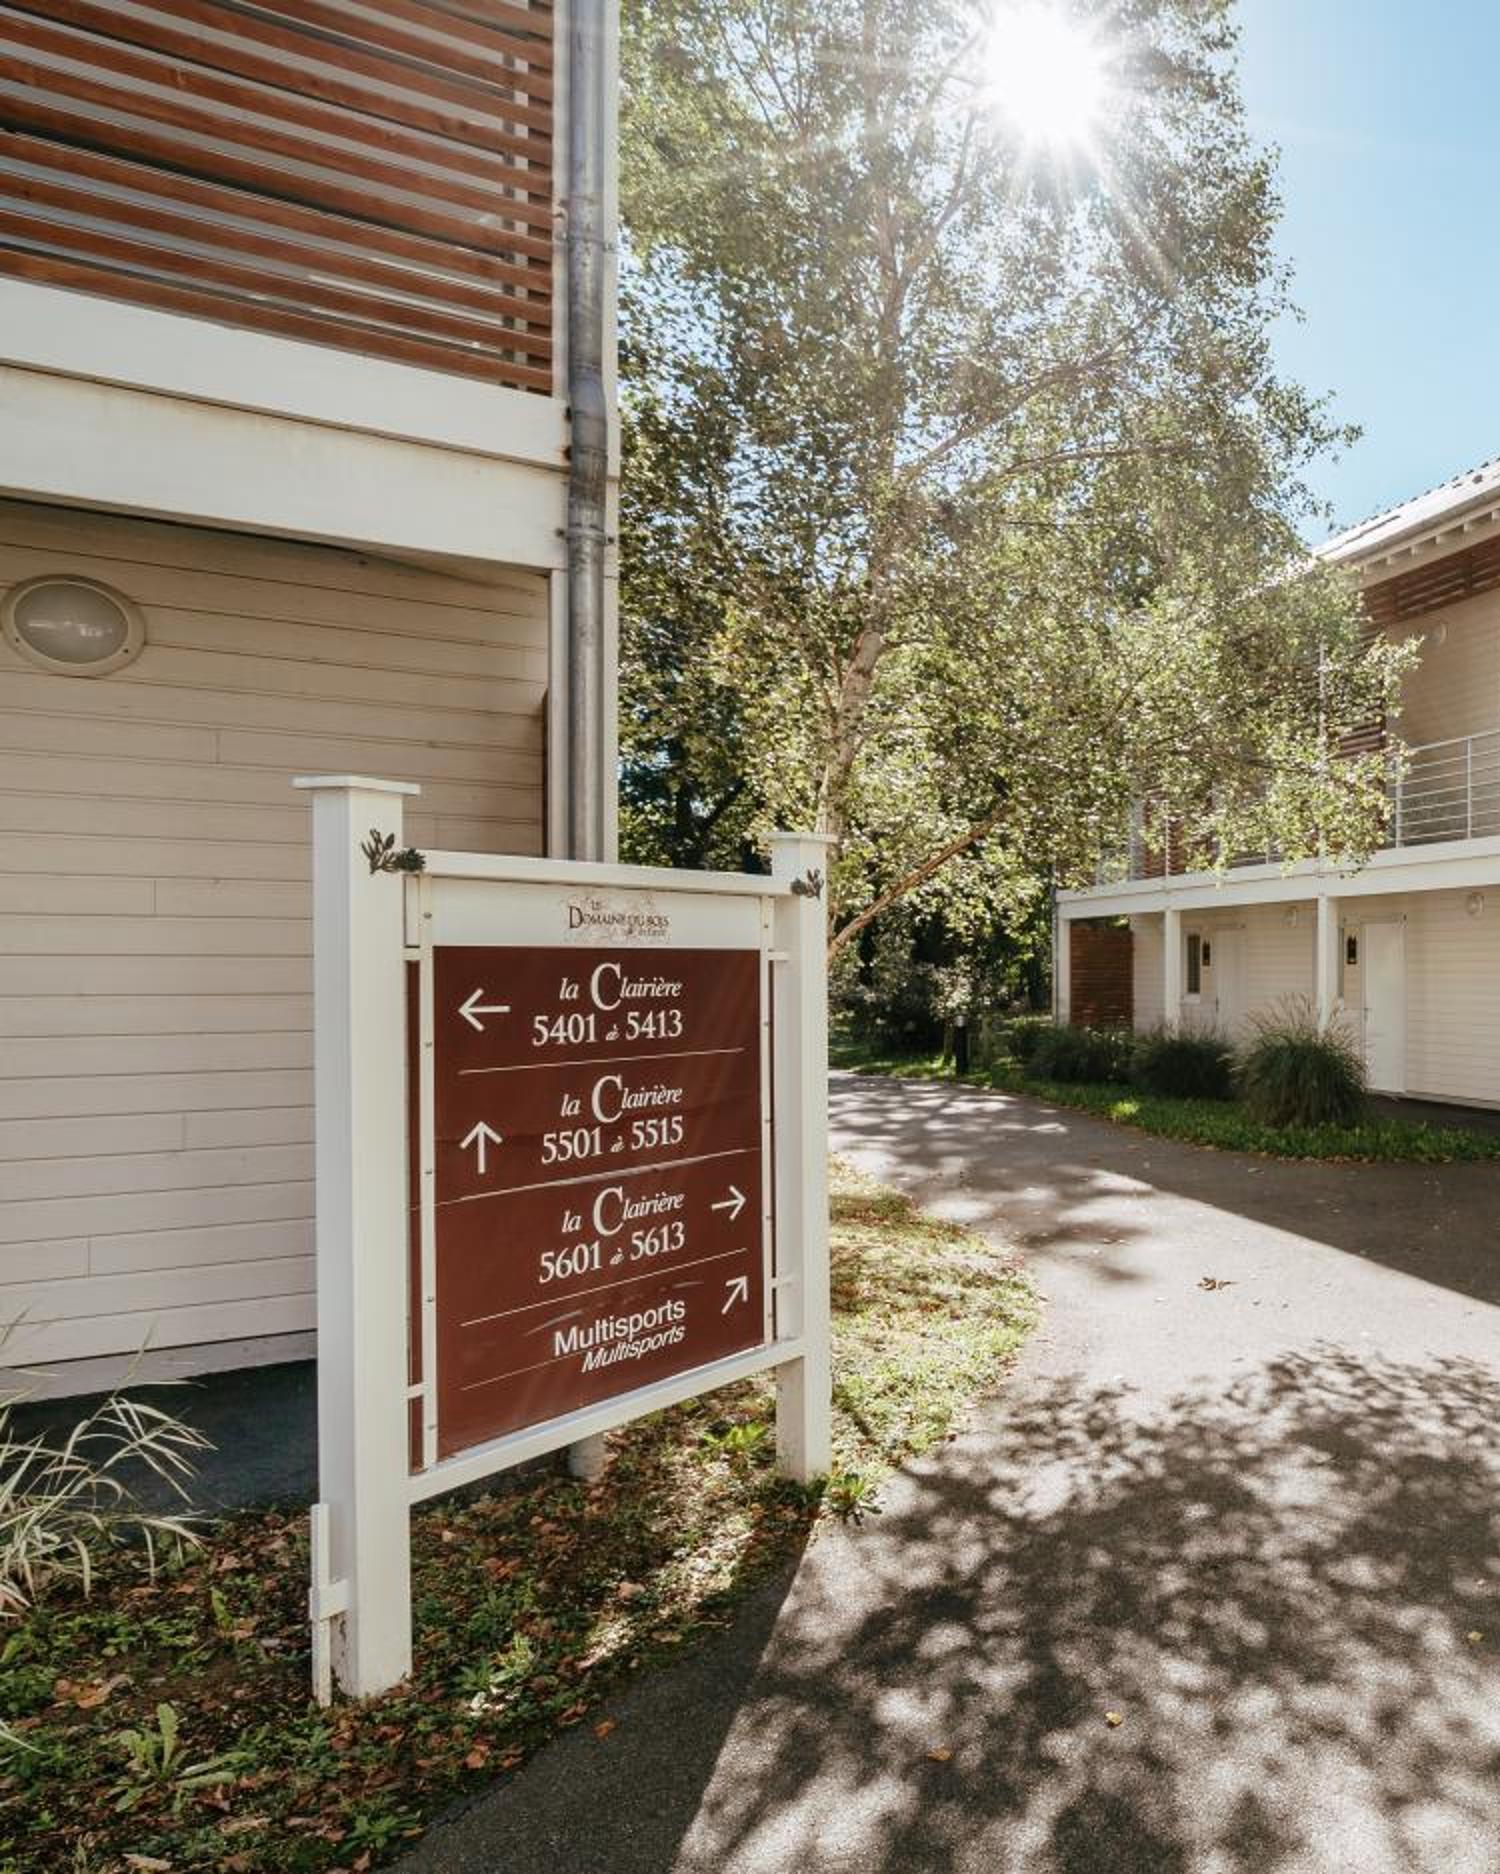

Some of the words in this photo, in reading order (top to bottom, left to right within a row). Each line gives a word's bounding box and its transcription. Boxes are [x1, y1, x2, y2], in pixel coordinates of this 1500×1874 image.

[559, 977, 580, 1000] la
[590, 962, 683, 1012] Clairière
[532, 1012, 599, 1047] 5401
[605, 1023, 620, 1041] à
[625, 1009, 683, 1041] 5413
[560, 1093, 581, 1117] la
[591, 1073, 683, 1124] Clairière
[541, 1125, 604, 1165] 5501
[610, 1135, 625, 1153] à
[631, 1115, 684, 1150] 5515
[561, 1210, 582, 1233] la
[592, 1185, 685, 1237] Clairière
[538, 1239, 603, 1284] 5601
[609, 1247, 625, 1265] à
[630, 1221, 686, 1261] 5613
[553, 1299, 686, 1357] Multisports
[581, 1324, 686, 1374] Multisports
